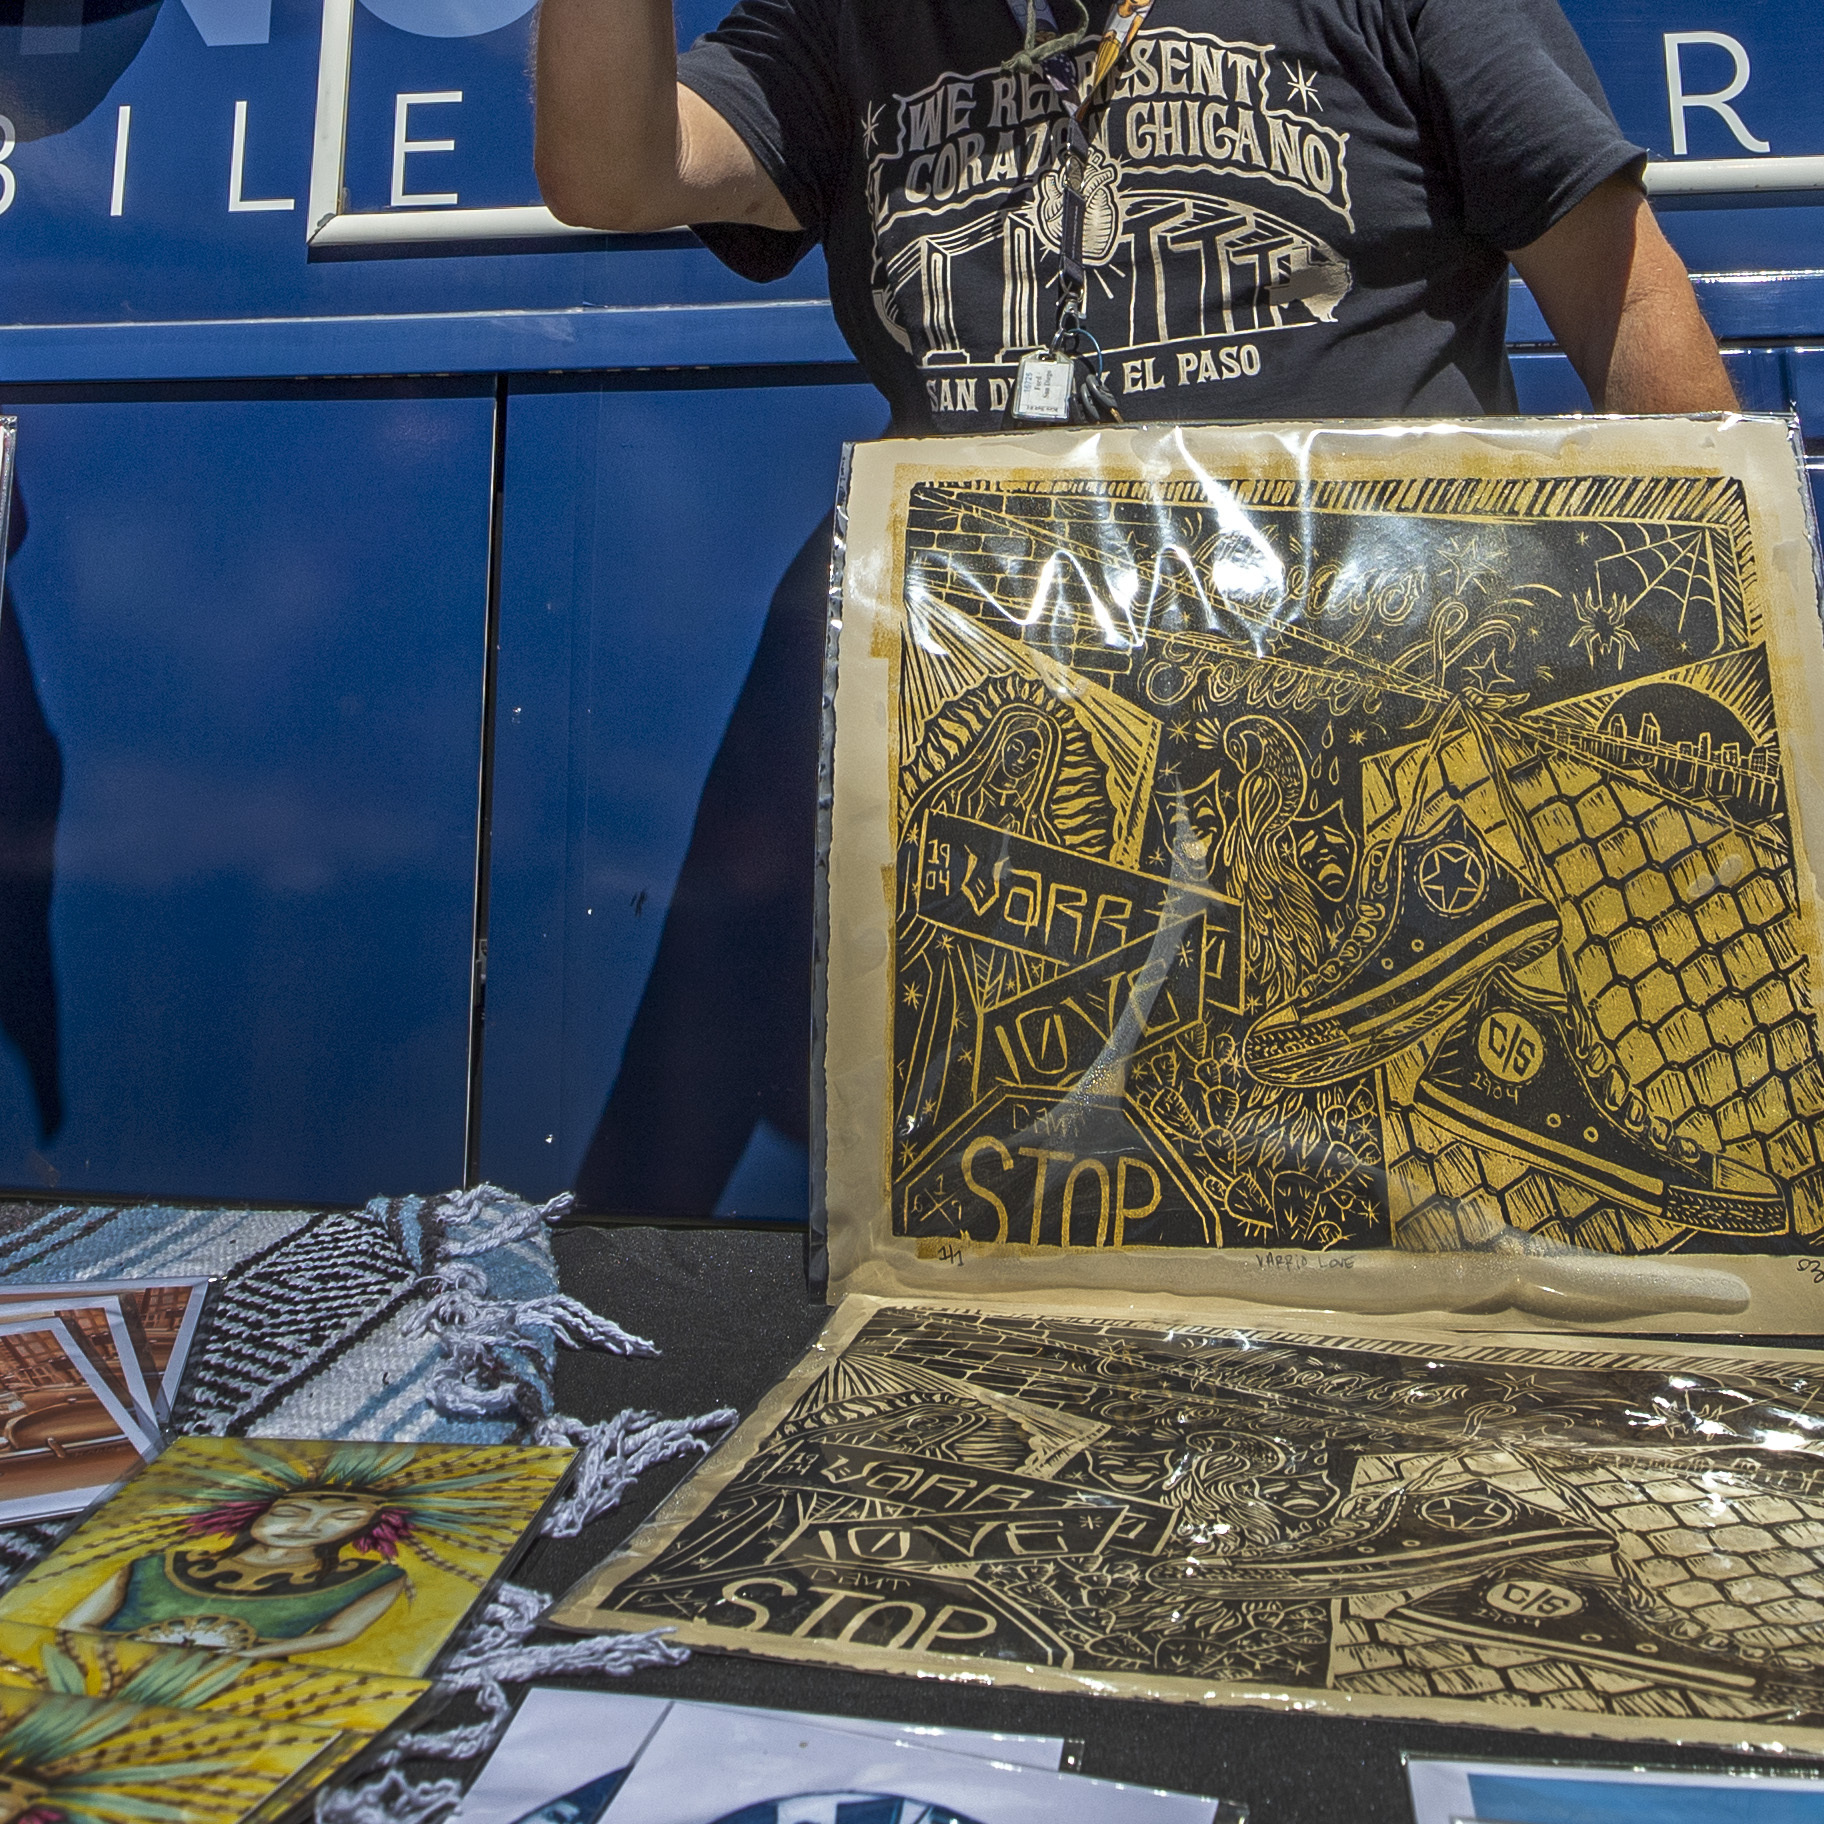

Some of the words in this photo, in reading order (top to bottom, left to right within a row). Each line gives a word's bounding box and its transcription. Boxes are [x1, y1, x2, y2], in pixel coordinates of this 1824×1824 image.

[909, 82, 977, 152] WE
[1125, 101, 1335, 195] CHICANO
[926, 378, 978, 412] SAN
[1122, 357, 1167, 394] EL
[1176, 344, 1262, 387] PASO
[1488, 1016, 1532, 1077] C/S
[1469, 1071, 1519, 1105] 1904
[961, 1134, 1163, 1247] STOP
[1318, 1254, 1358, 1270] LOVE
[721, 1577, 997, 1652] STOP
[1502, 1582, 1571, 1615] C/S
